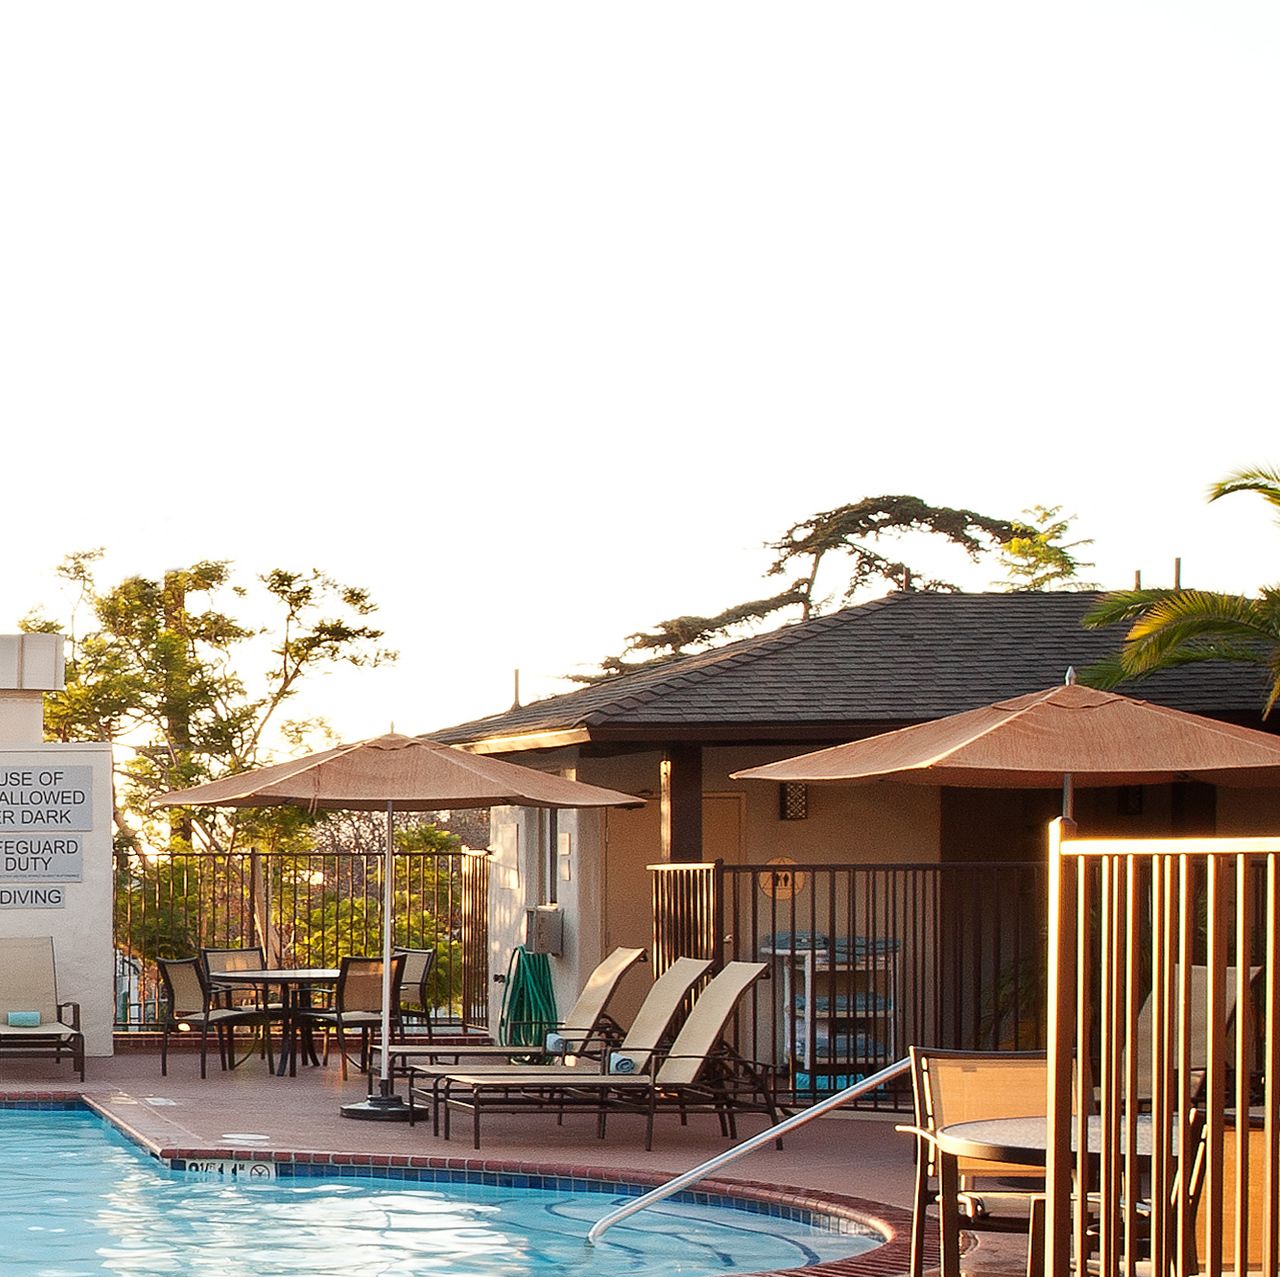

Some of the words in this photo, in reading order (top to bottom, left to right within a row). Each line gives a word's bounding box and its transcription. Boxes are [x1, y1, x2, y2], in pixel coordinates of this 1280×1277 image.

[39, 771, 63, 786] OF
[21, 809, 72, 824] DARK
[5, 857, 53, 871] DUTY
[0, 889, 62, 904] DIVING
